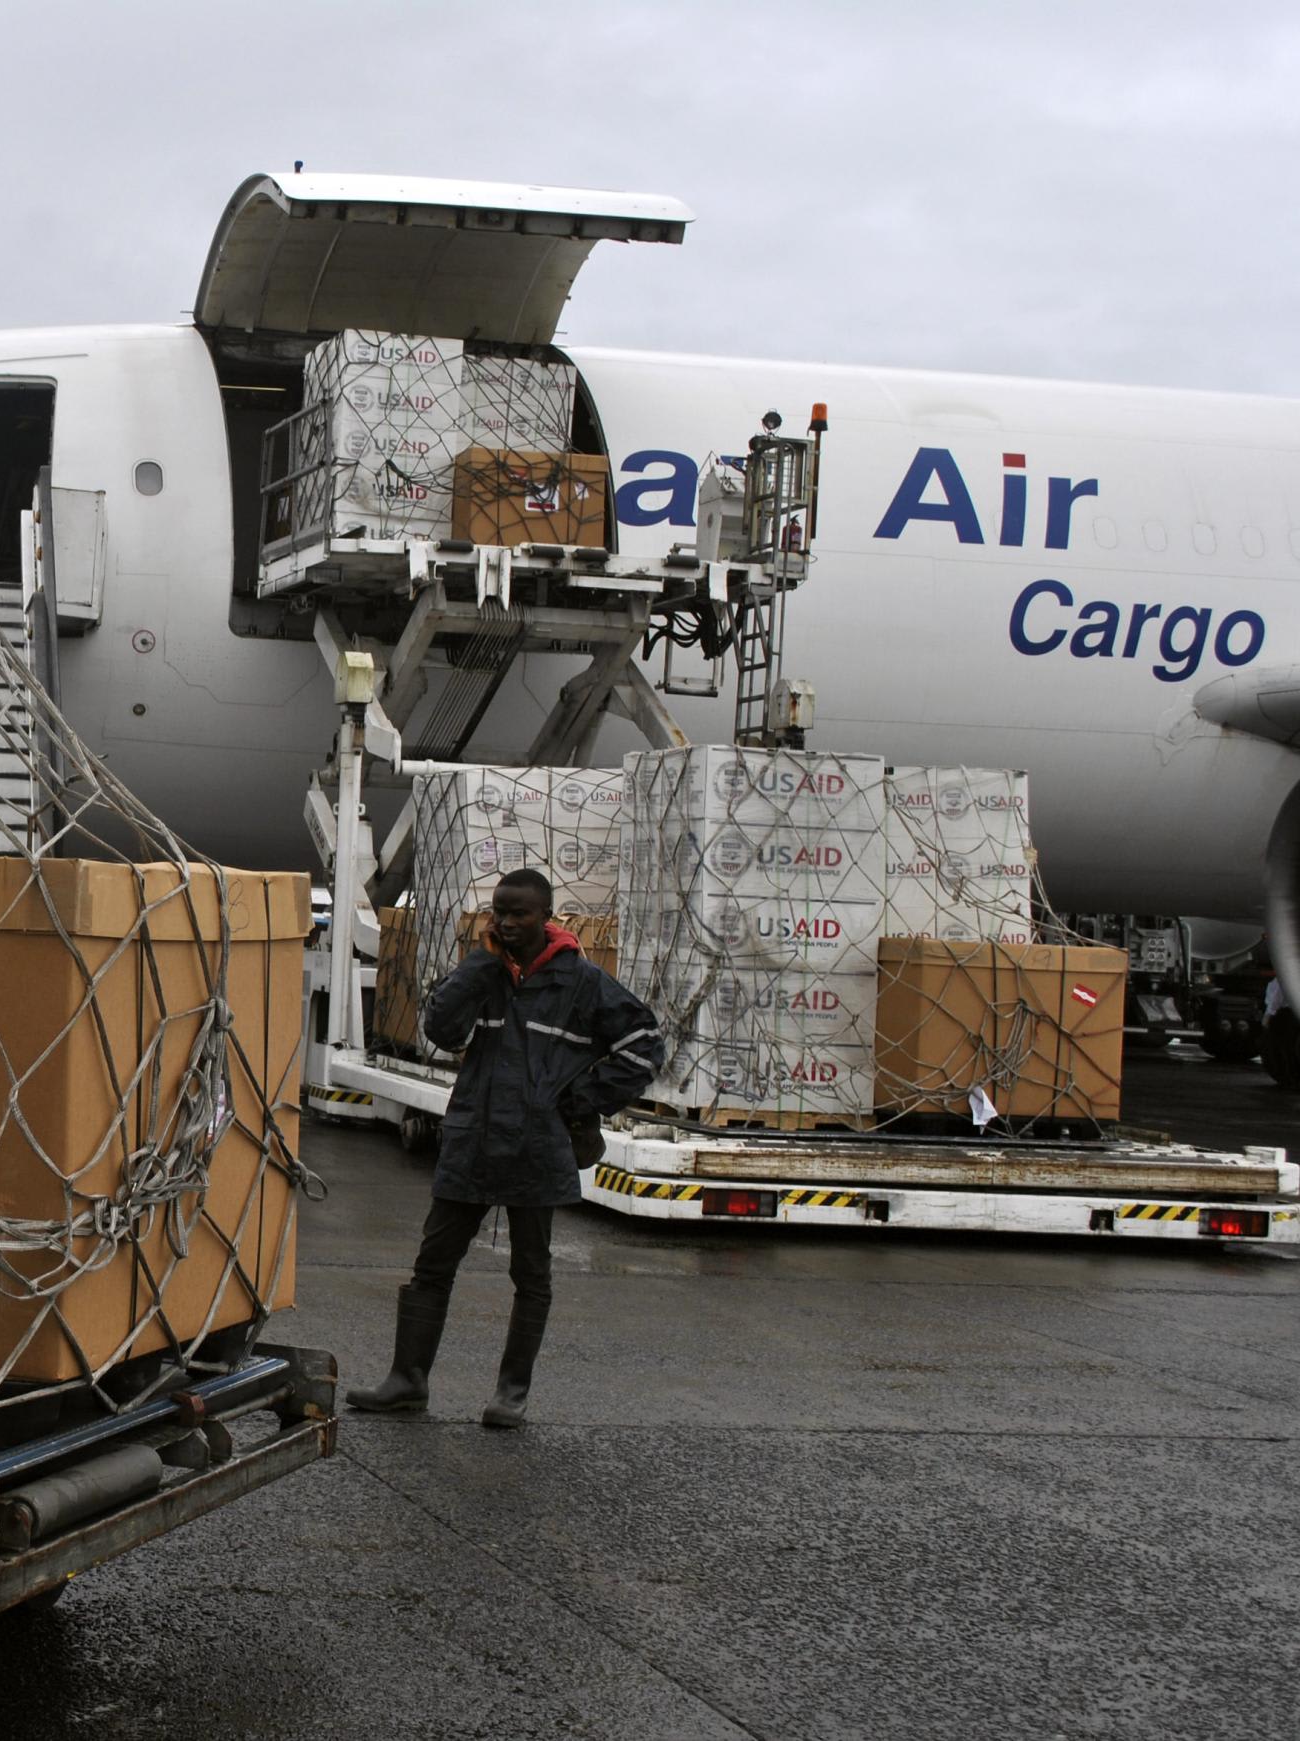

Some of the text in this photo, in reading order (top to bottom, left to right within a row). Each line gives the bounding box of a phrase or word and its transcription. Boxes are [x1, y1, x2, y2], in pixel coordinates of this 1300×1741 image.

[381, 347, 436, 363] USAID
[378, 392, 436, 409] USAID
[376, 439, 429, 454] USAID
[373, 482, 427, 499] USAID
[872, 446, 1097, 550] Air
[1010, 579, 1265, 683] Cargo
[760, 771, 844, 794] USAID
[508, 792, 542, 801] USAID
[979, 795, 1023, 807] USAID
[757, 846, 842, 866] USAID
[886, 863, 931, 874] USAID
[981, 864, 1025, 876] USAID
[758, 917, 840, 938] USAID
[757, 989, 839, 1010] USAID
